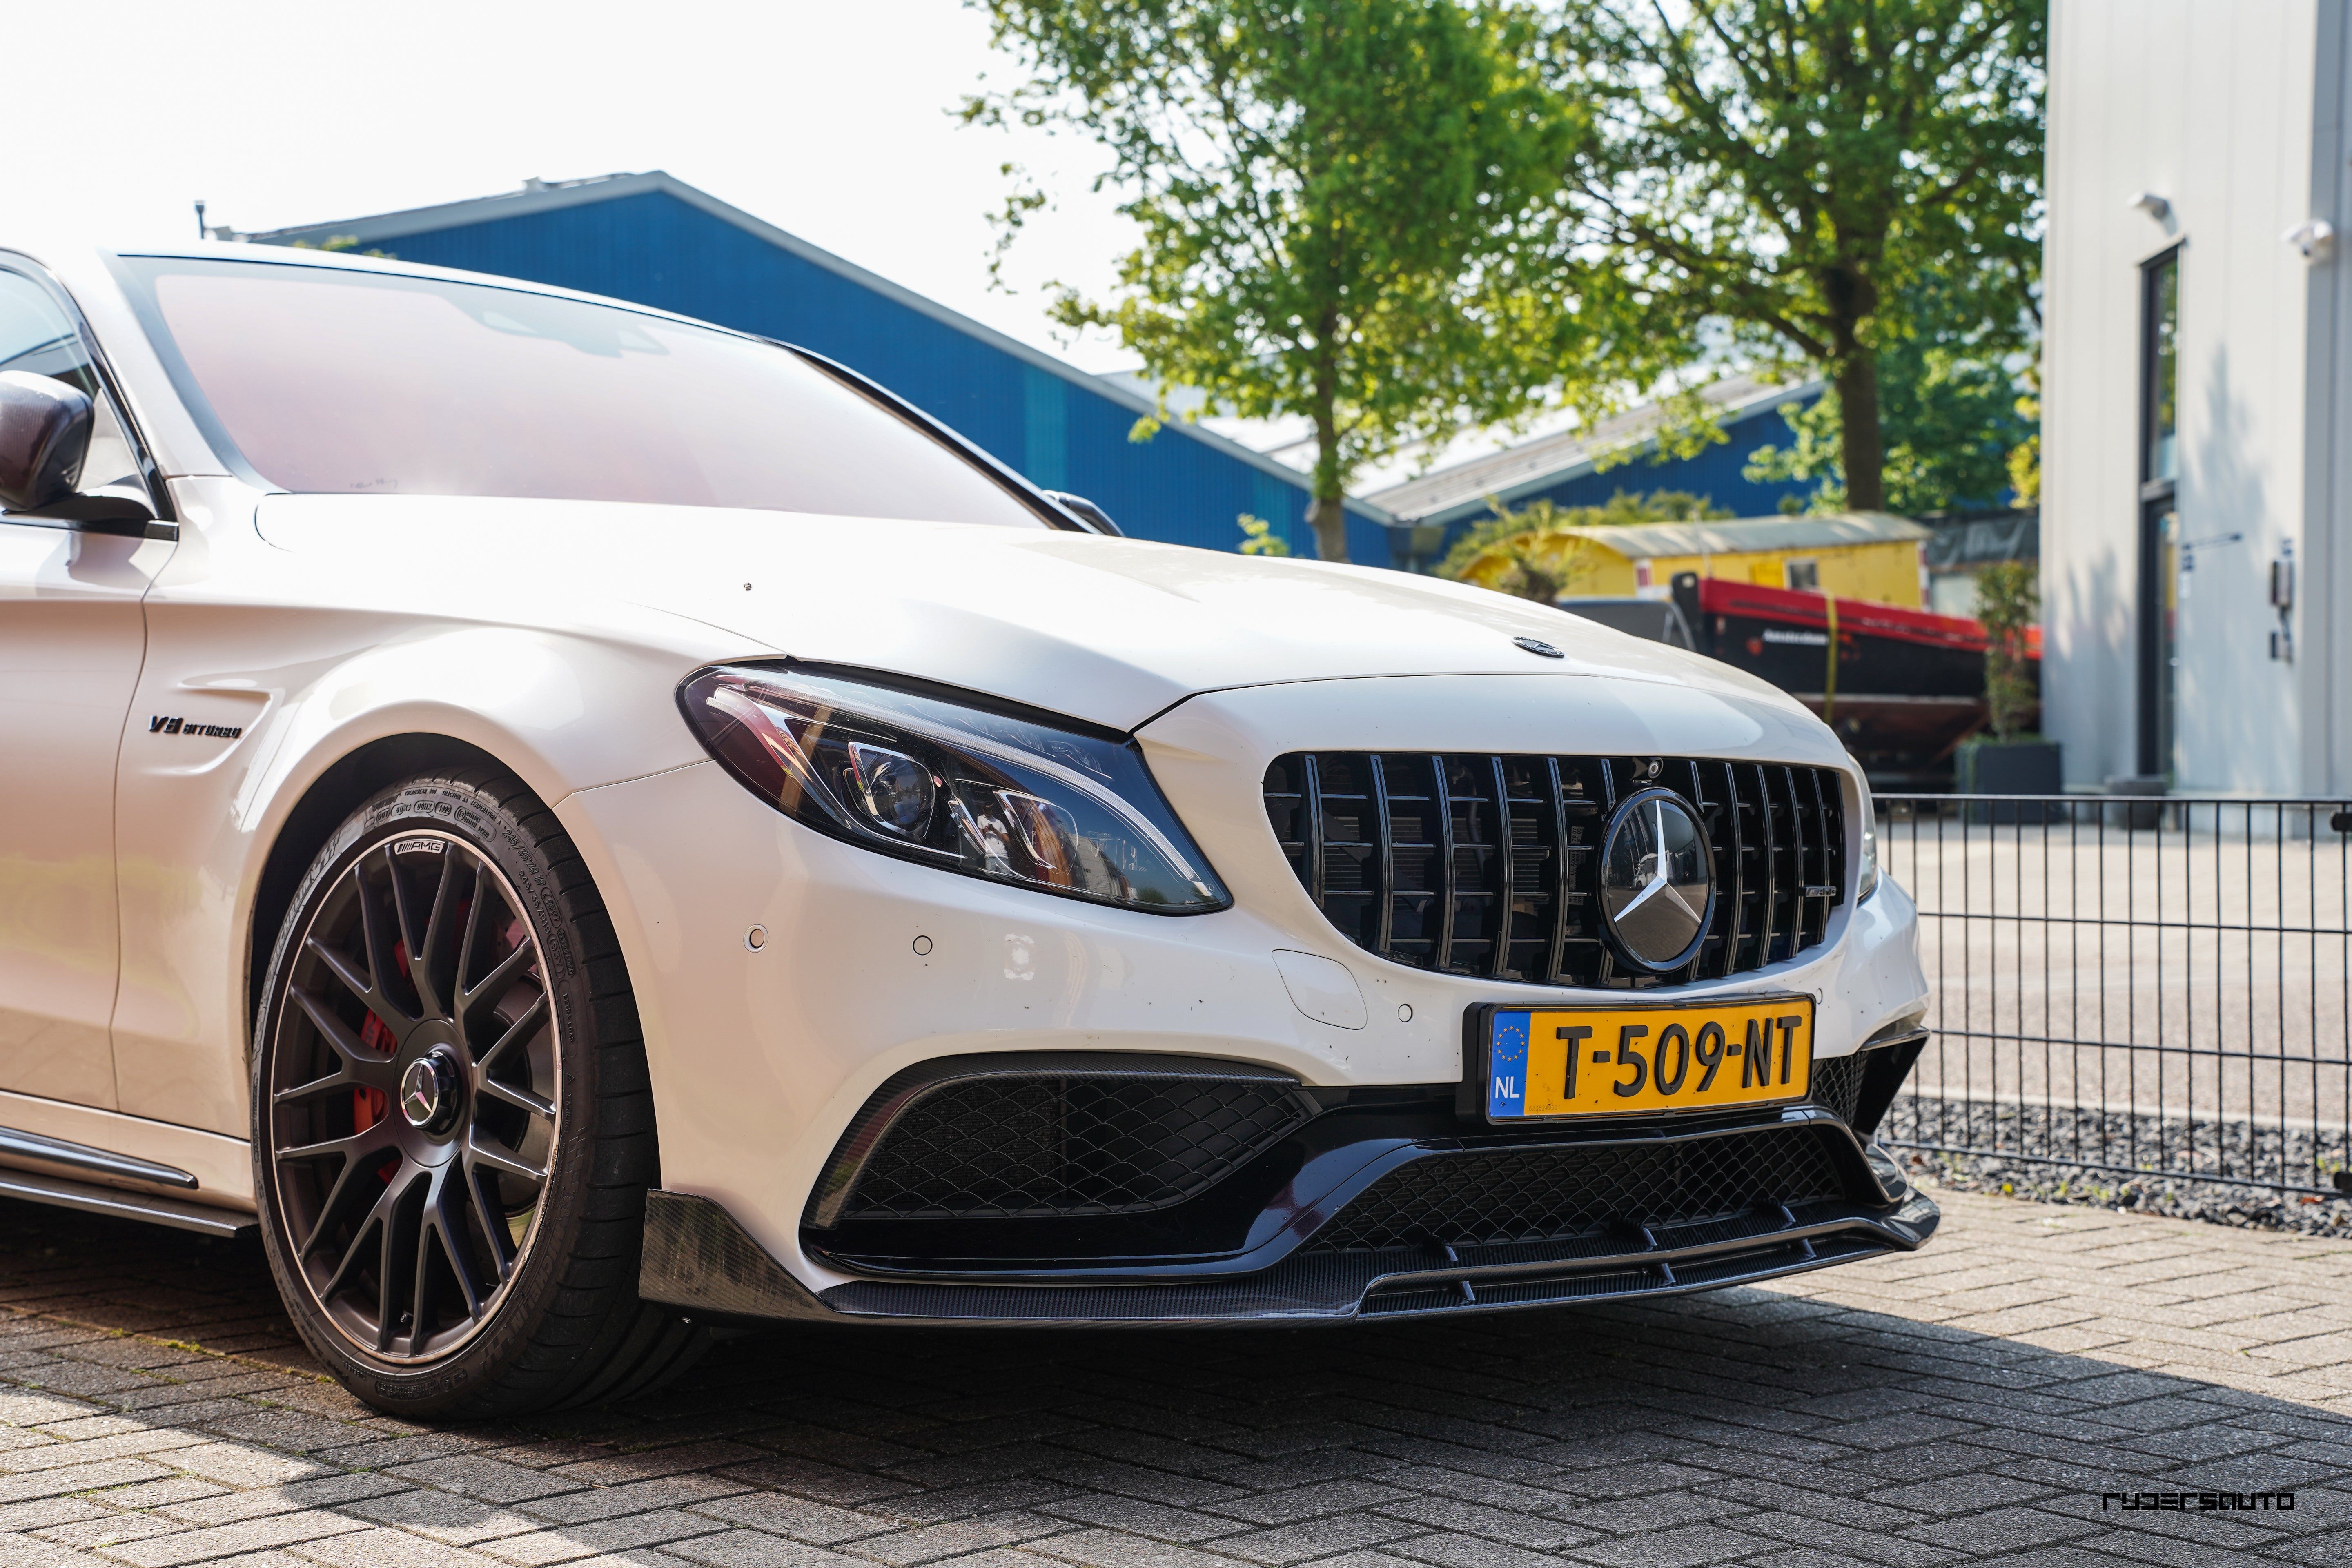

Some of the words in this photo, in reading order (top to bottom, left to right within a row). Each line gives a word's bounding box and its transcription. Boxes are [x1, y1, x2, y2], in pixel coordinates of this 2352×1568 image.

[149, 715, 183, 733] V8
[183, 723, 243, 739] BITURBO
[442, 790, 461, 800] TRACTION
[470, 800, 498, 822] TEMPERATURE
[411, 841, 441, 851] AMG
[563, 993, 571, 1019] EXTRA
[1555, 1015, 1802, 1100] T-509-NT
[1494, 1076, 1520, 1098] NL
